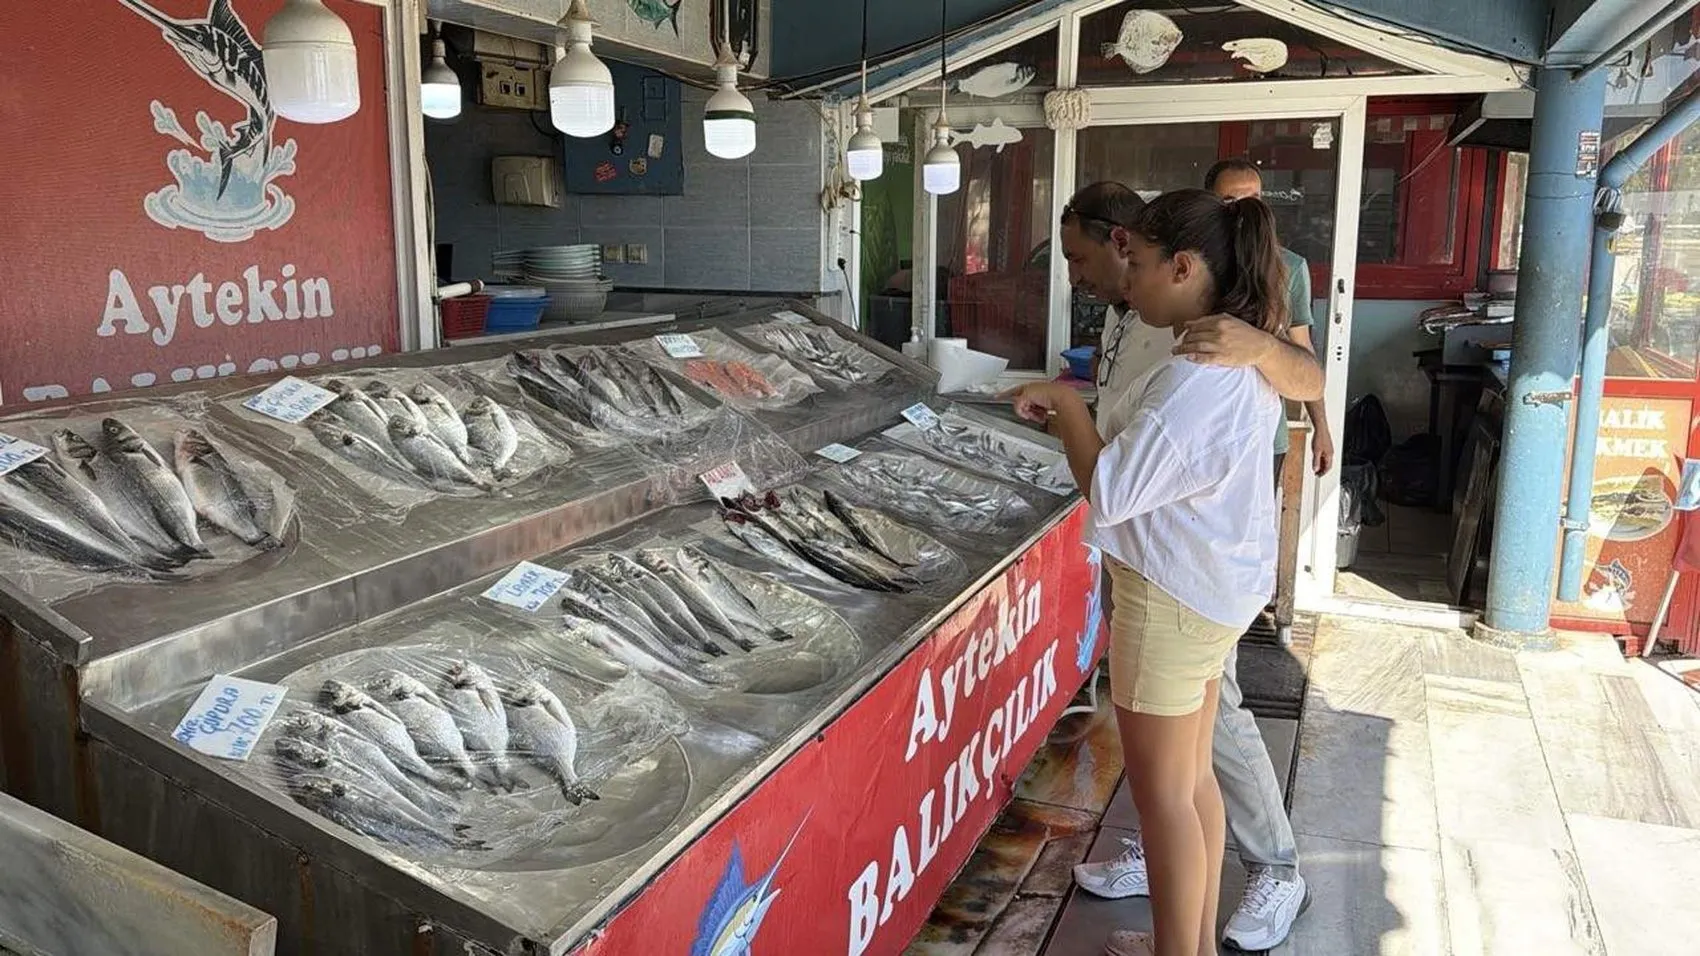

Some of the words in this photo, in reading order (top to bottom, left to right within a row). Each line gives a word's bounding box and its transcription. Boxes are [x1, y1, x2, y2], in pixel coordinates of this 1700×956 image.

[97, 264, 333, 346] Aytekin
[1596, 437, 1668, 458] KMEK
[1600, 404, 1666, 430] ALİK
[905, 578, 1041, 763] Aytekin
[849, 639, 1059, 956] BALIKÇILIK
